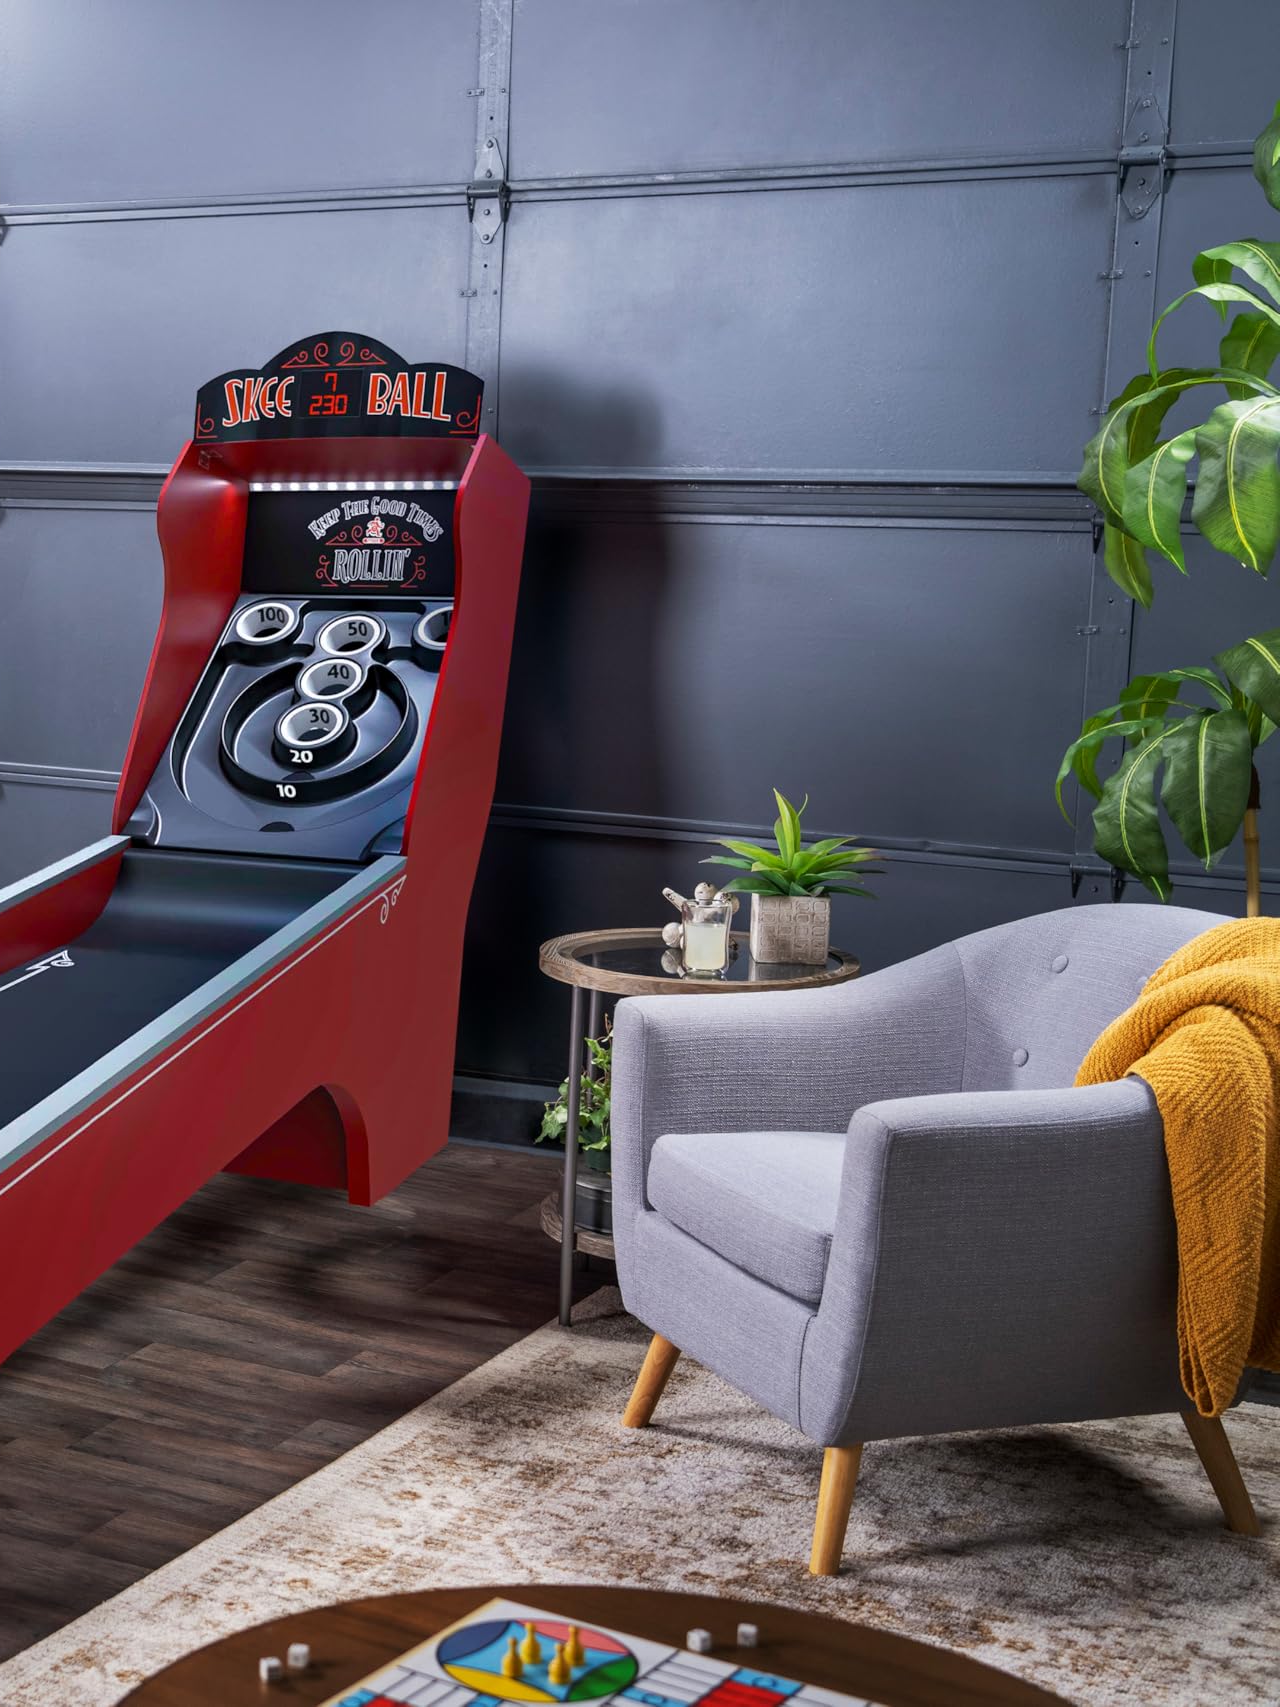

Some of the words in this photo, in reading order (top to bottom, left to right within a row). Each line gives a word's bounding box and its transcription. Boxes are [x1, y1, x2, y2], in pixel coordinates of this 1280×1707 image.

[324, 373, 338, 393] 7
[222, 375, 295, 427] SKEE
[367, 372, 451, 422] BALL
[309, 394, 348, 416] 230
[257, 605, 286, 625] 100
[347, 620, 368, 637] 50
[327, 663, 351, 681] 40
[309, 708, 331, 724] 30
[289, 748, 314, 764] 20
[276, 783, 298, 799] 10
